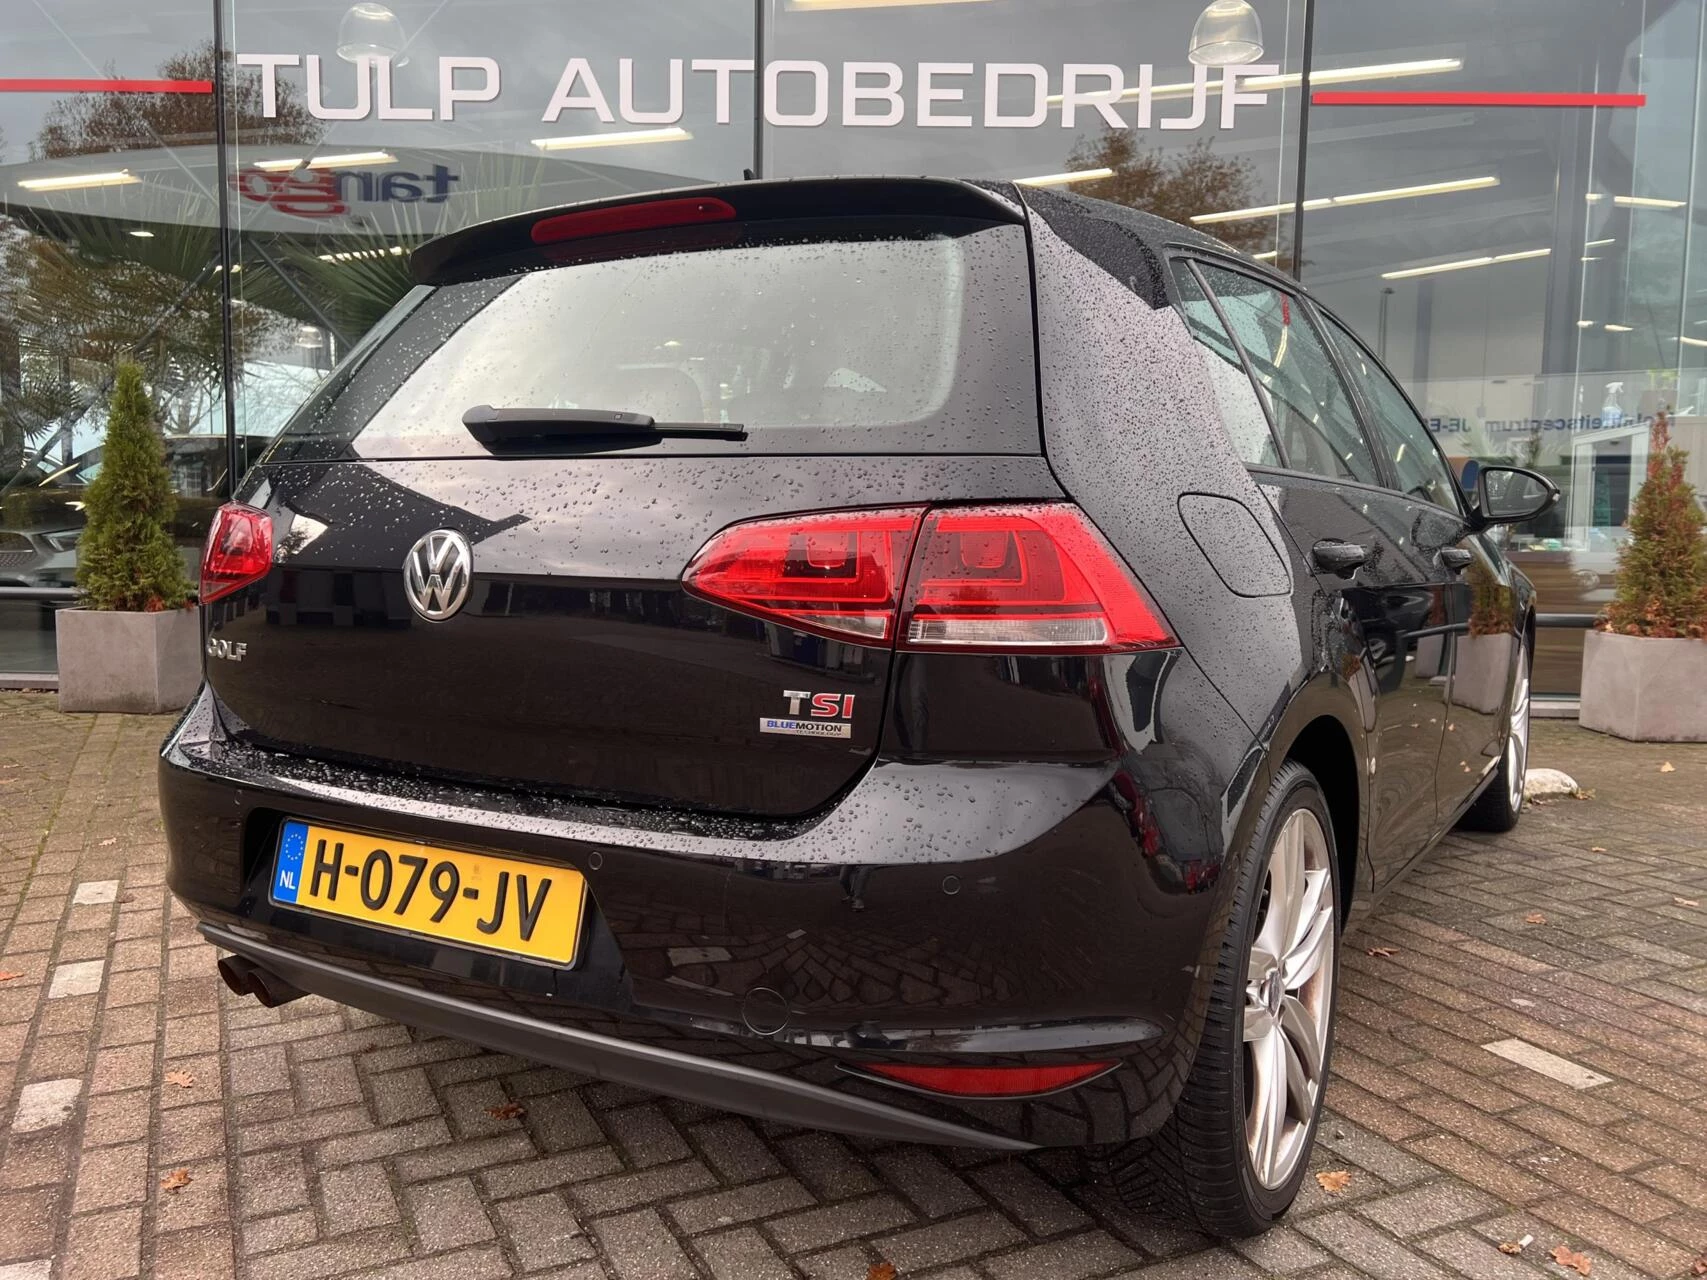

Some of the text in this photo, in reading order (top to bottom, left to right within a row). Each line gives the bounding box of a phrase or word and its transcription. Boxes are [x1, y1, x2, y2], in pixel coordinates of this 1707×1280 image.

[237, 53, 1280, 130] TULP AUTOBEDRIJF
[207, 638, 248, 662] GOLF
[783, 690, 855, 719] TSI
[767, 720, 842, 732] BLUEMOTION
[279, 869, 296, 890] NL
[309, 839, 552, 942] H-079-JV
